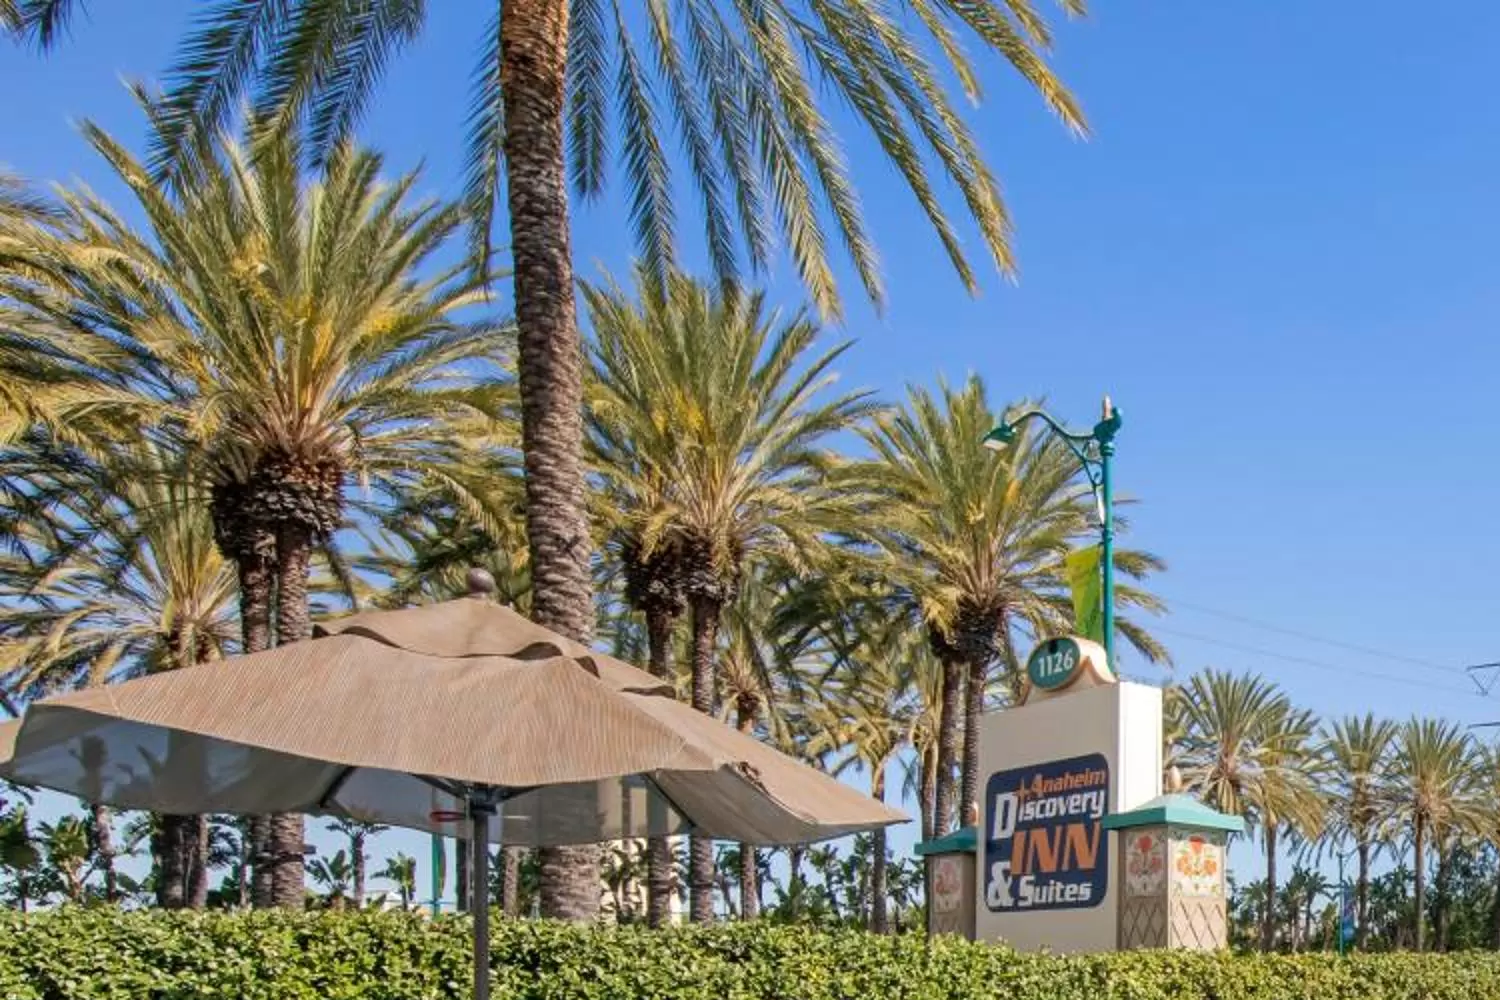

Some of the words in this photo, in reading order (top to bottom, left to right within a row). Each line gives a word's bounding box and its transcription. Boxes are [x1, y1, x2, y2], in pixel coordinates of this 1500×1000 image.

[1038, 648, 1074, 678] 1126
[1031, 767, 1106, 797] Anaheim
[992, 790, 1106, 840] Discovery
[1010, 821, 1100, 876] INN
[987, 861, 1014, 907] &
[1017, 874, 1092, 907] Suites
